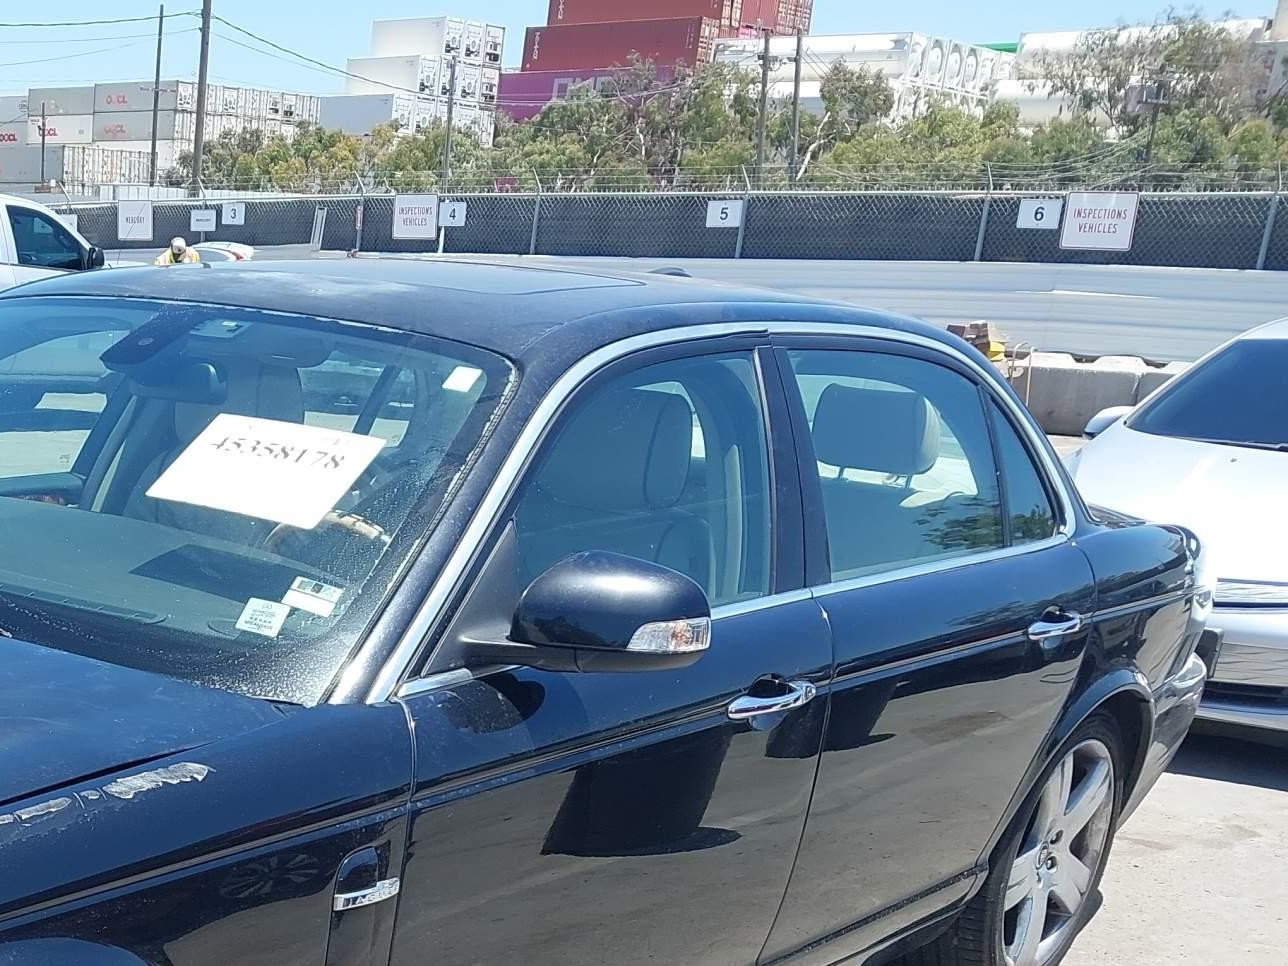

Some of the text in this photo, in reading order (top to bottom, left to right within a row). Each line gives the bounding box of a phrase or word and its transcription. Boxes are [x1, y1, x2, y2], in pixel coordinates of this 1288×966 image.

[106, 95, 128, 105] OCL
[230, 208, 237, 220] 3
[398, 206, 433, 215] INSPECTIONS
[449, 207, 457, 220] 4
[719, 206, 729, 221] 5
[1033, 206, 1045, 222] 6
[1073, 207, 1128, 220] INSPECTIONS
[402, 218, 428, 226] VEHICLES
[1078, 222, 1119, 234] VEHICLES
[210, 436, 345, 469] 45358178
